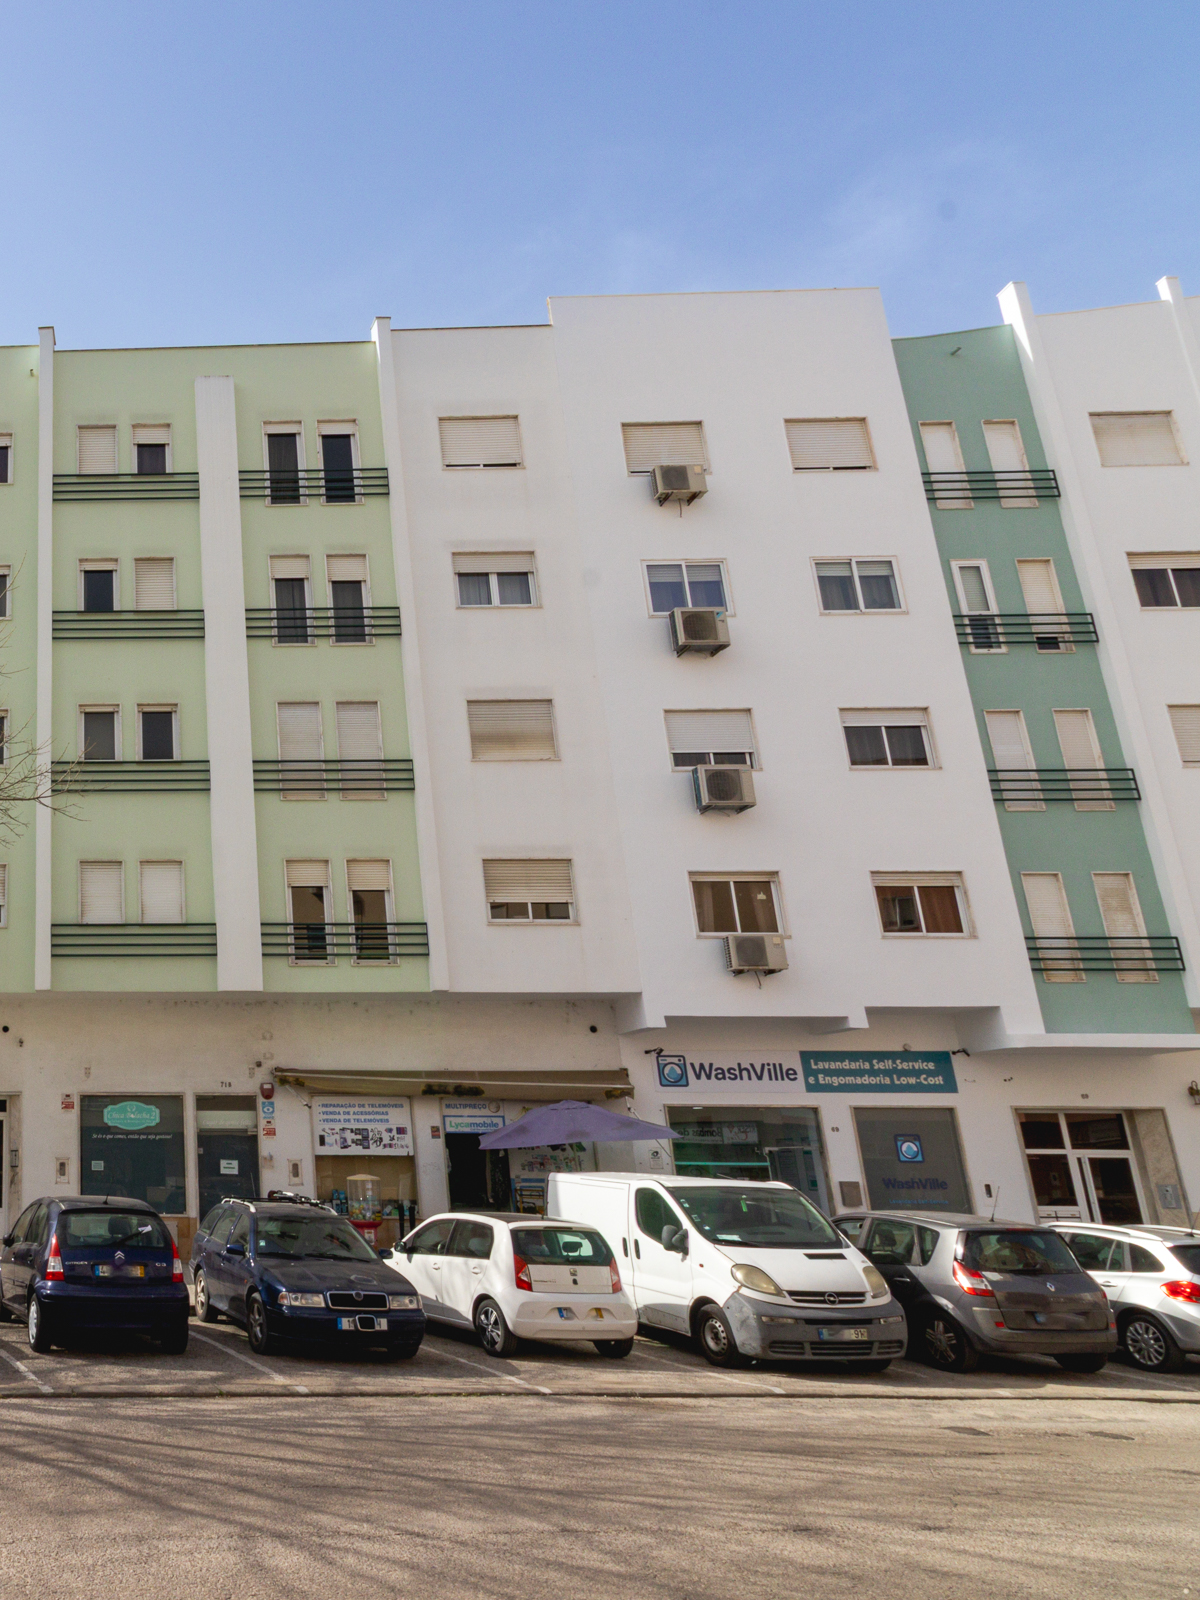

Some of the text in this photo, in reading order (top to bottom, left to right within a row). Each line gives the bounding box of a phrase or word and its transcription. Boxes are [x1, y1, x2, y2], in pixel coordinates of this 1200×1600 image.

[810, 1059, 936, 1070] Lavandaria Self-Service
[689, 1062, 798, 1082] WashVille
[808, 1073, 944, 1086] e Engomadoria Low-Cost
[449, 1120, 499, 1129] Lycamobile
[882, 1177, 949, 1190] WashVille
